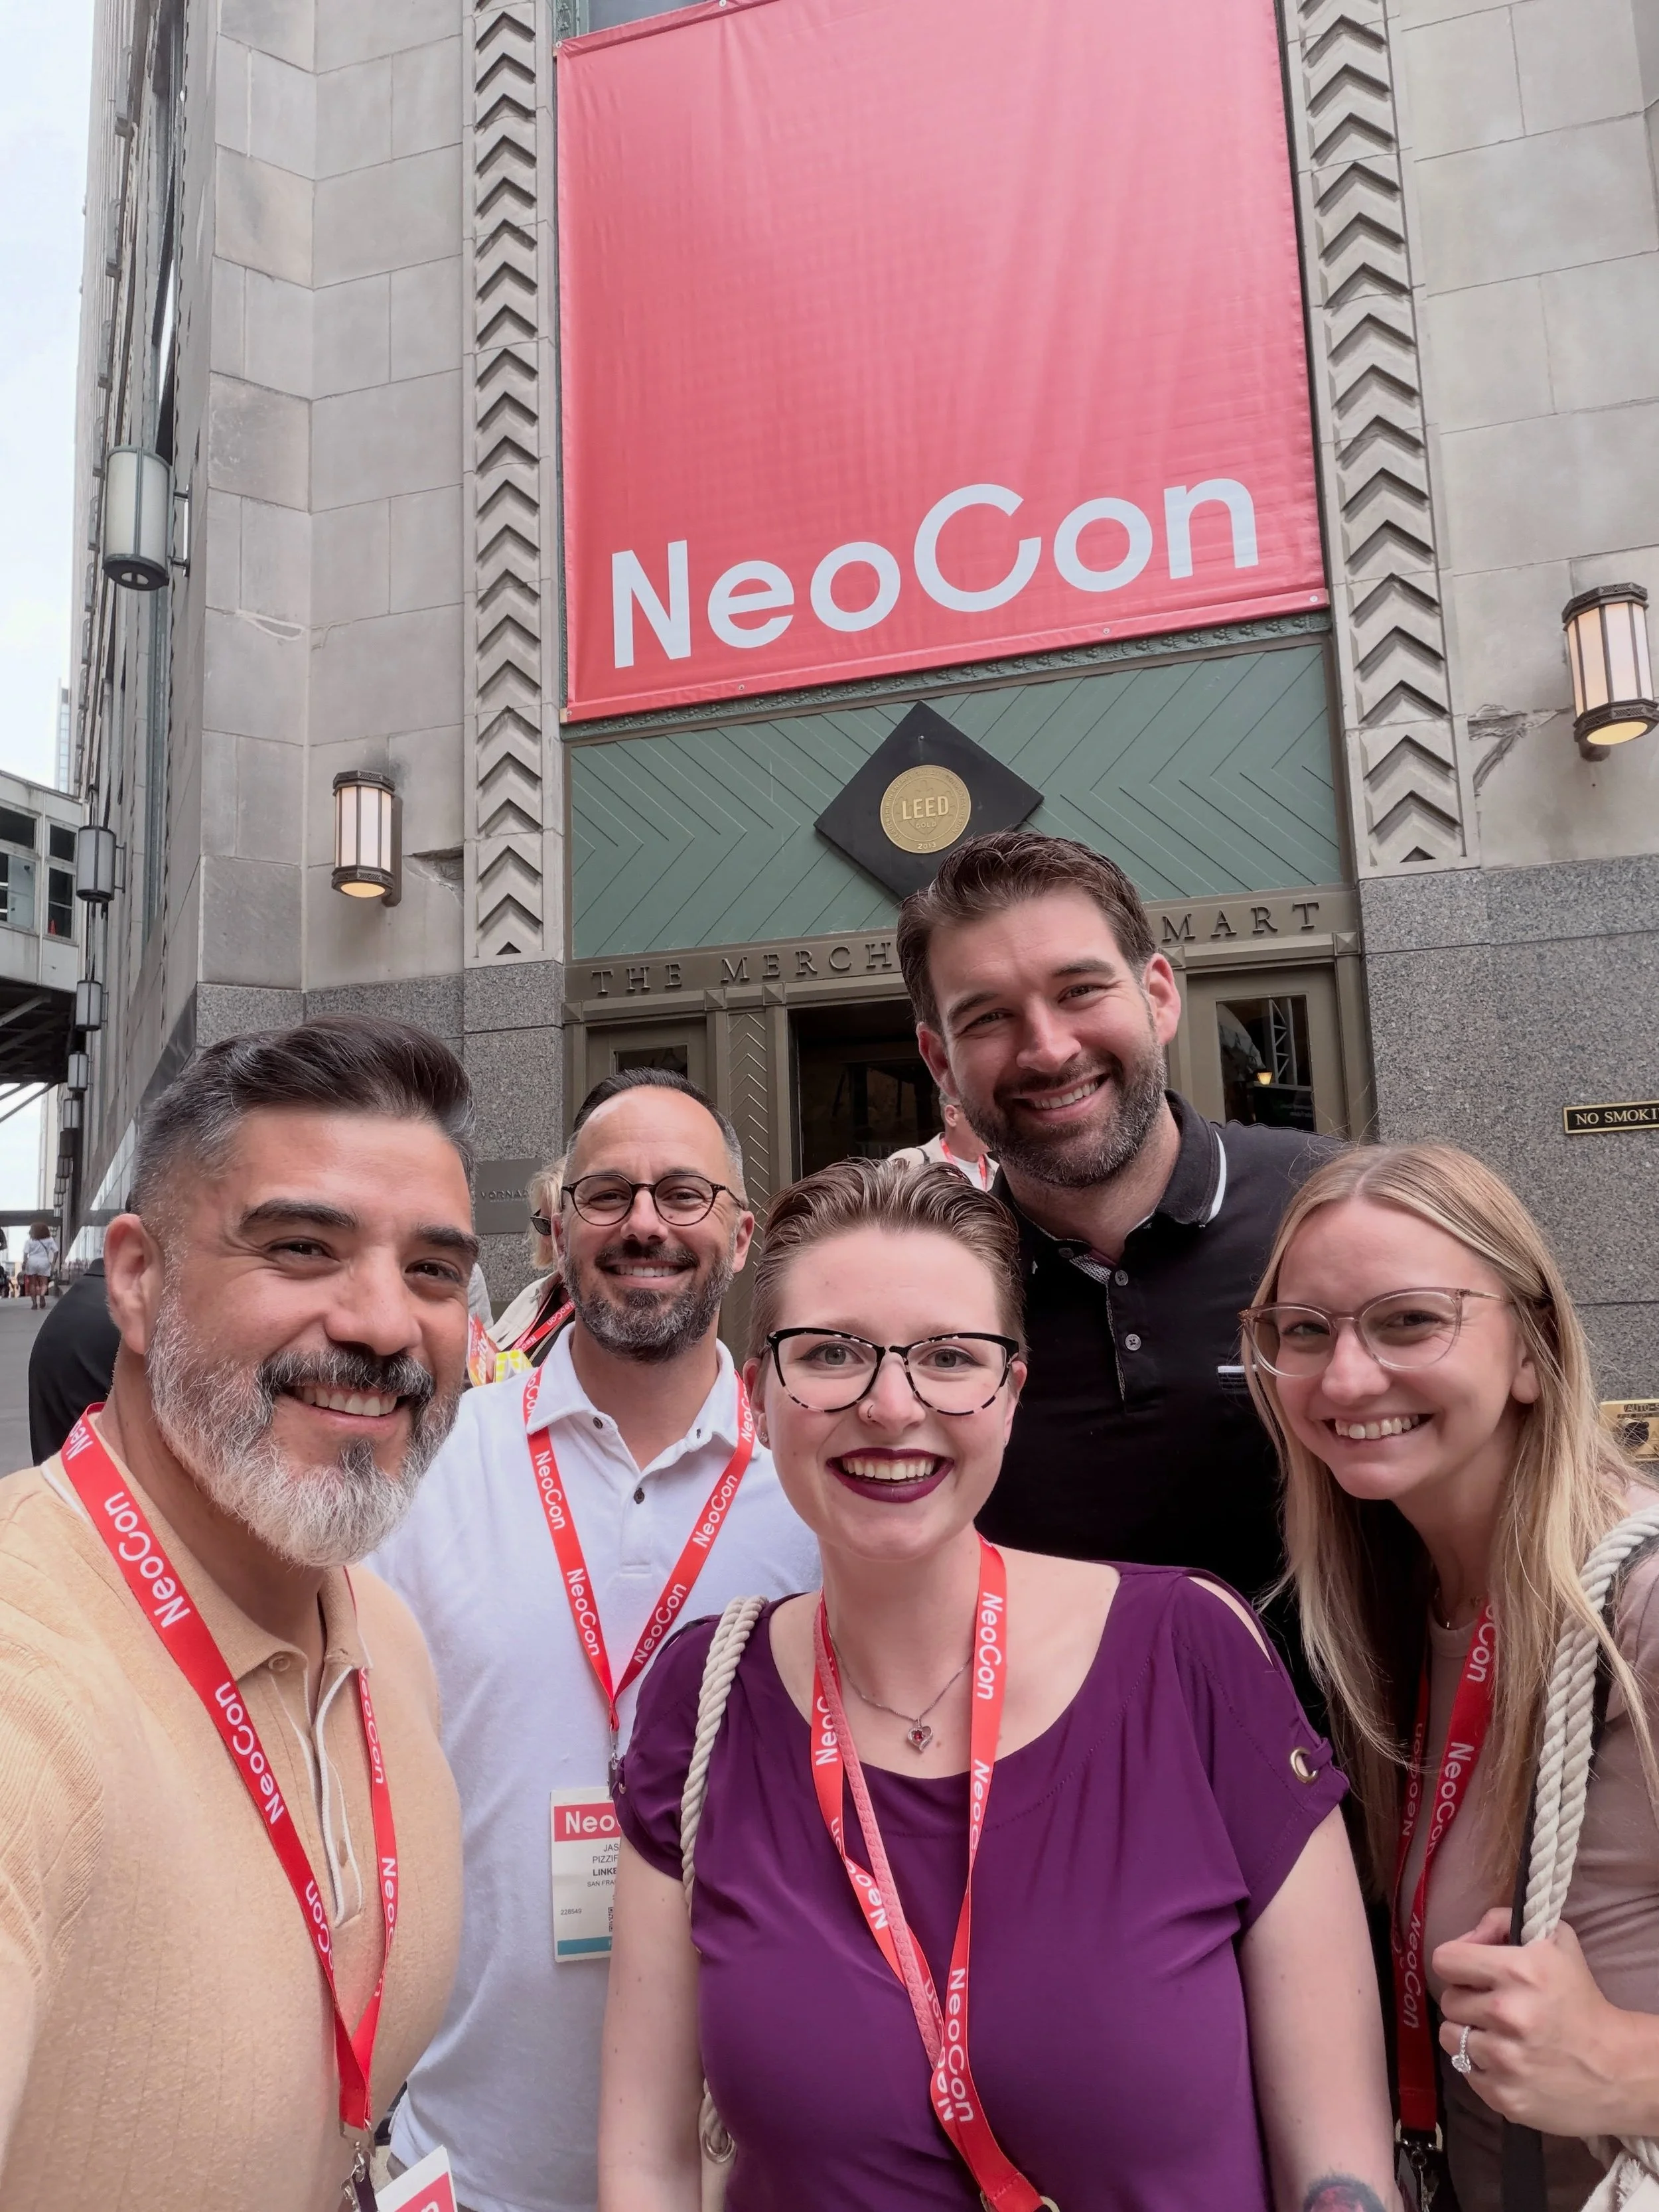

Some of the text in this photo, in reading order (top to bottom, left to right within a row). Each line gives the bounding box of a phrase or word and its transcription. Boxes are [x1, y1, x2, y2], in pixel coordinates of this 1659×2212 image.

[611, 477, 1260, 668] NeoCon
[902, 796, 949, 820] LEED
[591, 902, 1320, 994] THE MERCH MART
[1575, 1108, 1659, 1125] NO SMOKI
[521, 1335, 537, 1349] Neo
[547, 1299, 575, 1326] NeoCon
[65, 1418, 94, 1461] Neo
[535, 1449, 565, 1530] NeoCon
[692, 1474, 738, 1548] NeoCon
[104, 1491, 190, 1629] NeoCon
[567, 1568, 601, 1657] NeoCon
[634, 1583, 687, 1664] NeoCon
[977, 1591, 1003, 1700] NeoCon
[214, 1681, 285, 1824] NeoCon
[566, 1810, 615, 1834] Neo
[971, 1759, 990, 1850] NeoC
[593, 1867, 616, 1876] LINKE
[603, 1843, 619, 1852] JAS
[1404, 1912, 1421, 2029] NeoCon
[948, 1968, 974, 2122] NeoCon
